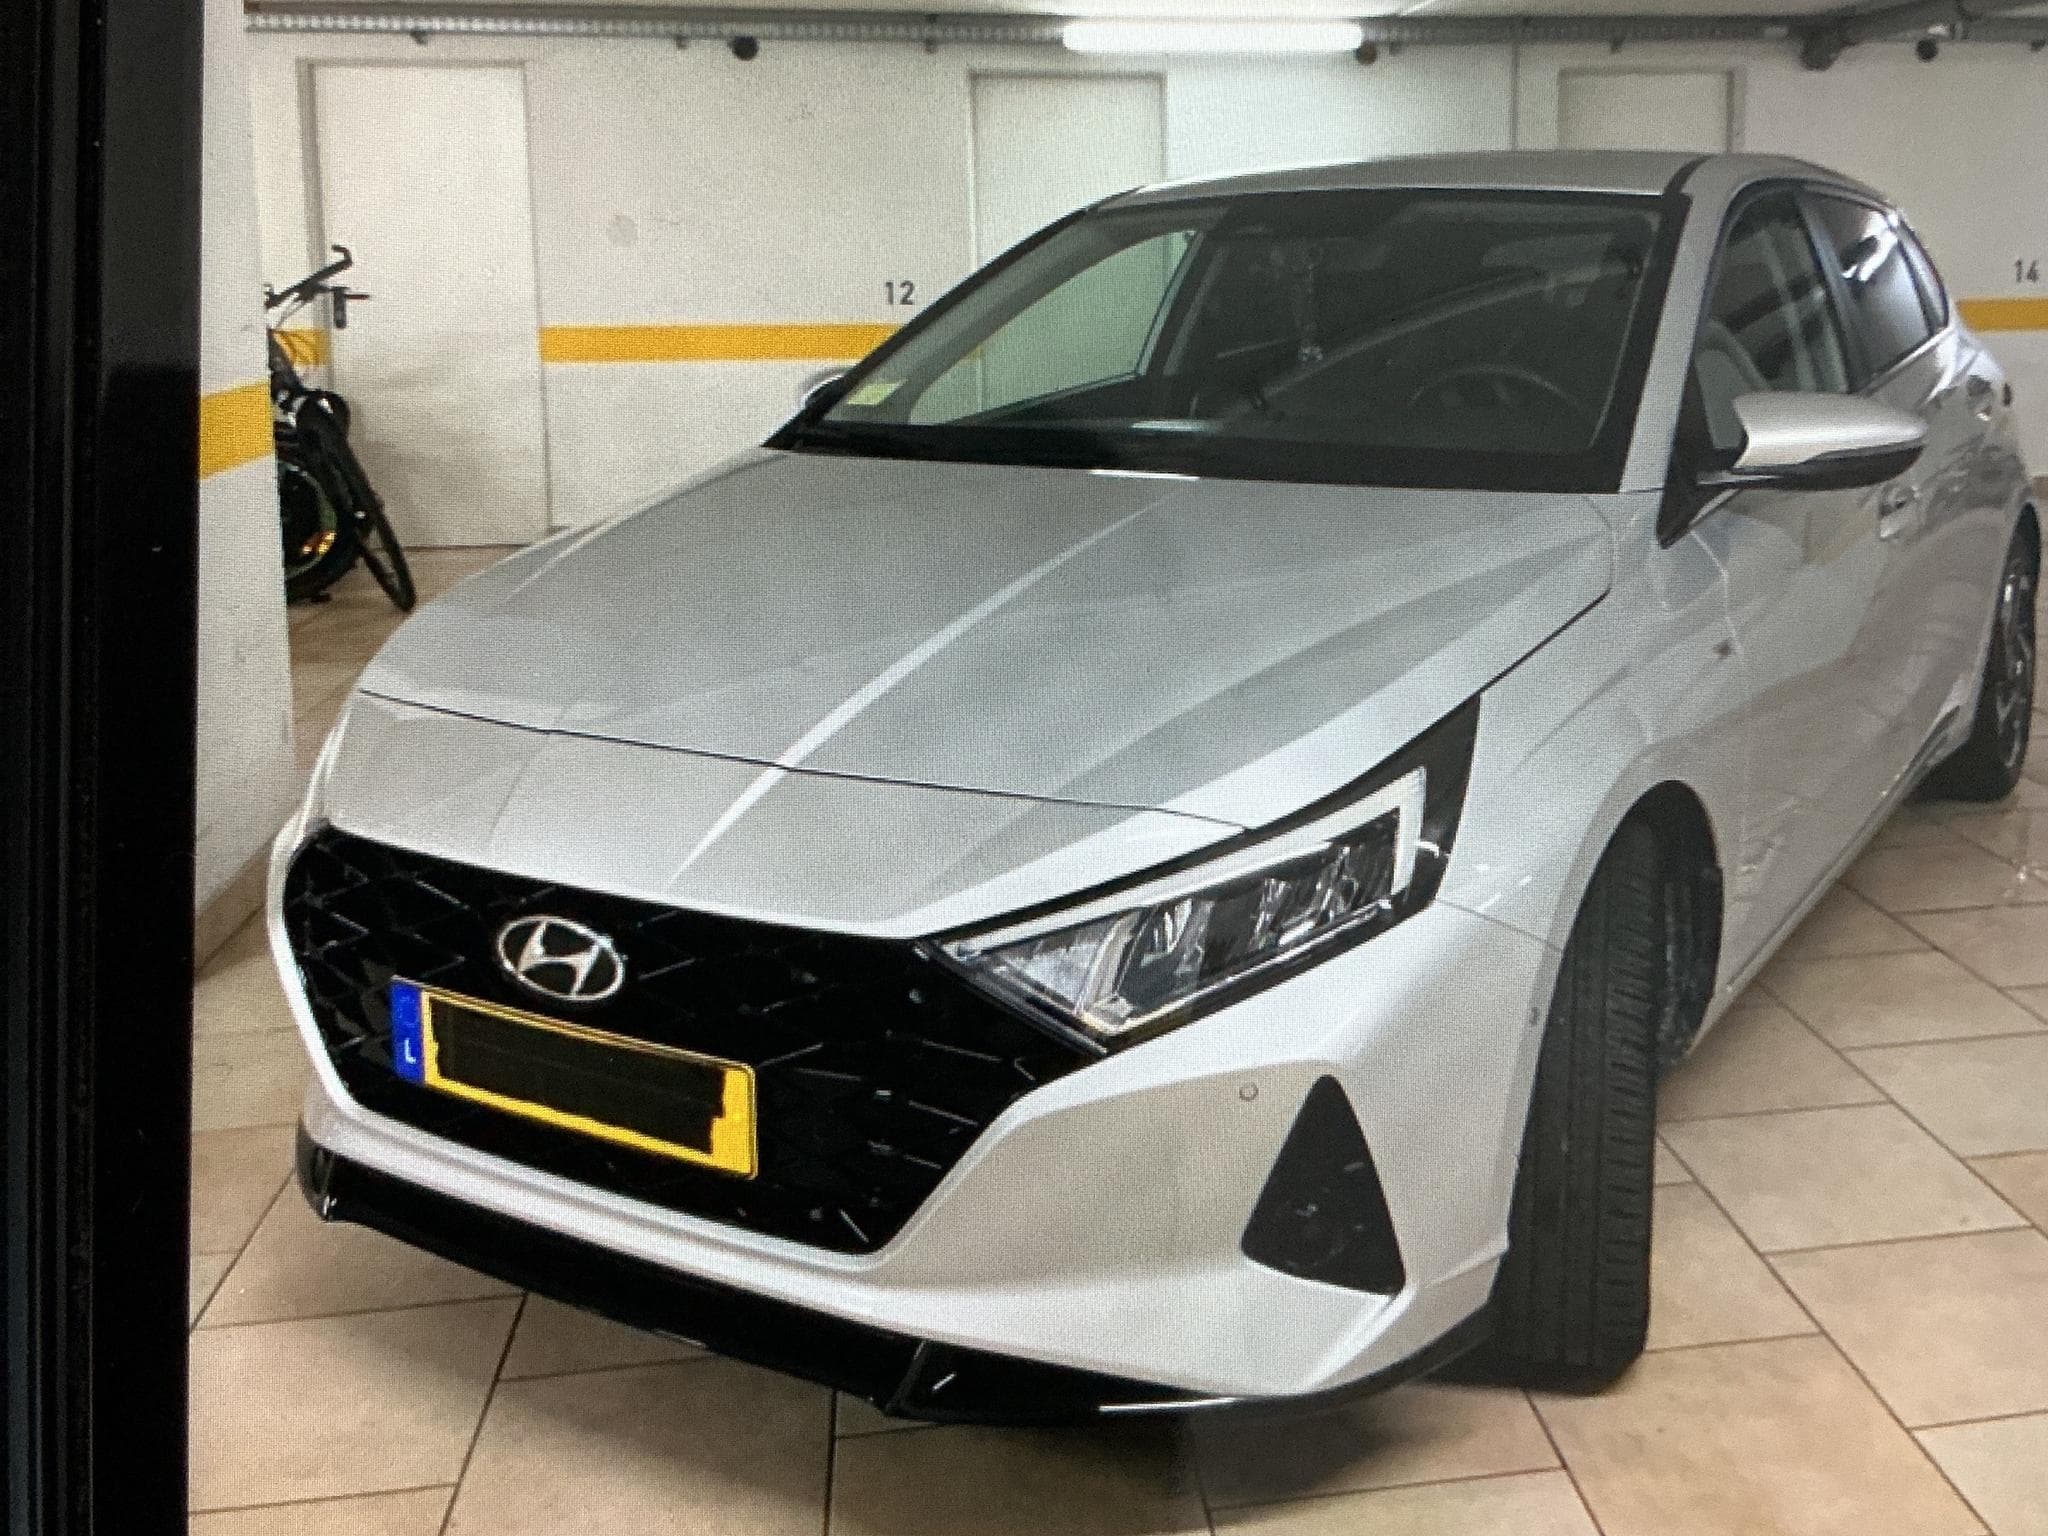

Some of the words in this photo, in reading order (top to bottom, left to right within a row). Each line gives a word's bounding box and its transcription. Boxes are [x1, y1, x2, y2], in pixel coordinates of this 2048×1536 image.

[2015, 259, 2040, 283] 14
[885, 280, 915, 305] 12
[404, 1037, 417, 1065] L
